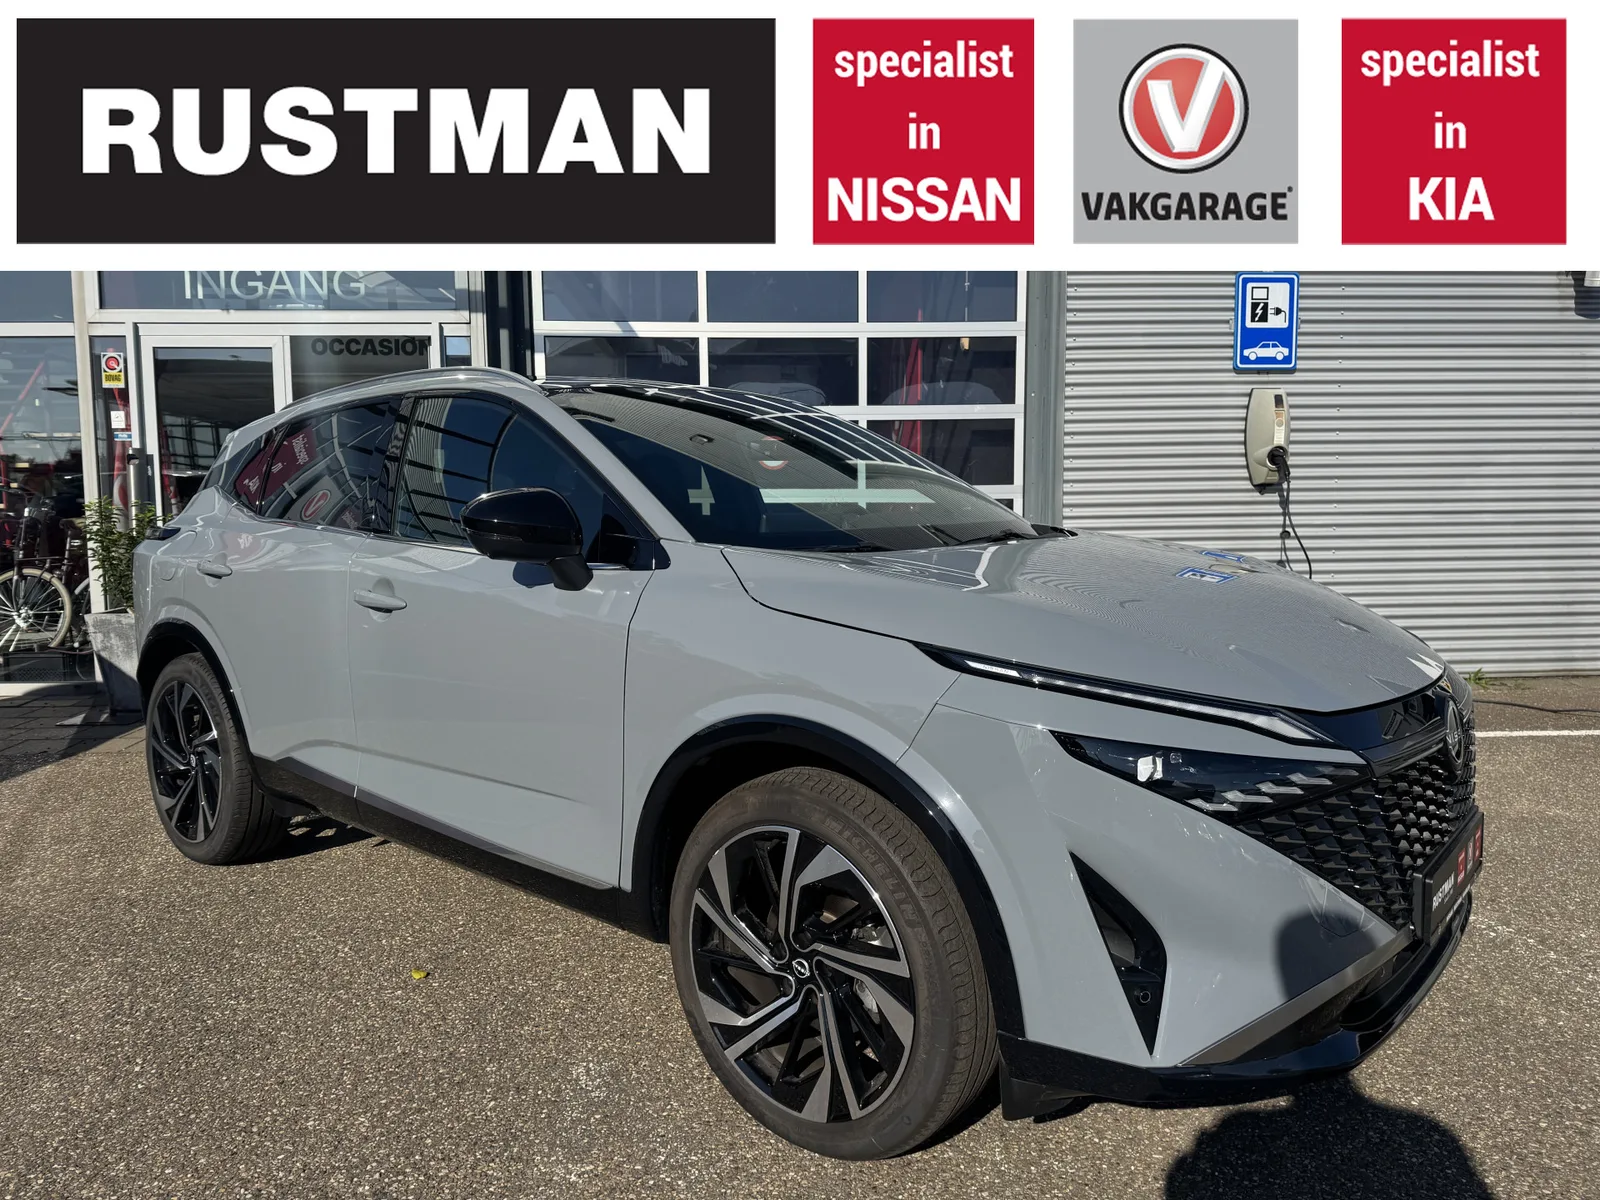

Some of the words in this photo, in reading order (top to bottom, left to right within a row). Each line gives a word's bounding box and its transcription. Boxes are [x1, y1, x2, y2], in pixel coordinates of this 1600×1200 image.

[184, 271, 365, 300] INGANG
[311, 337, 430, 356] OCCASION
[104, 373, 122, 382] BOVAG
[823, 815, 922, 928] MICHELIN
